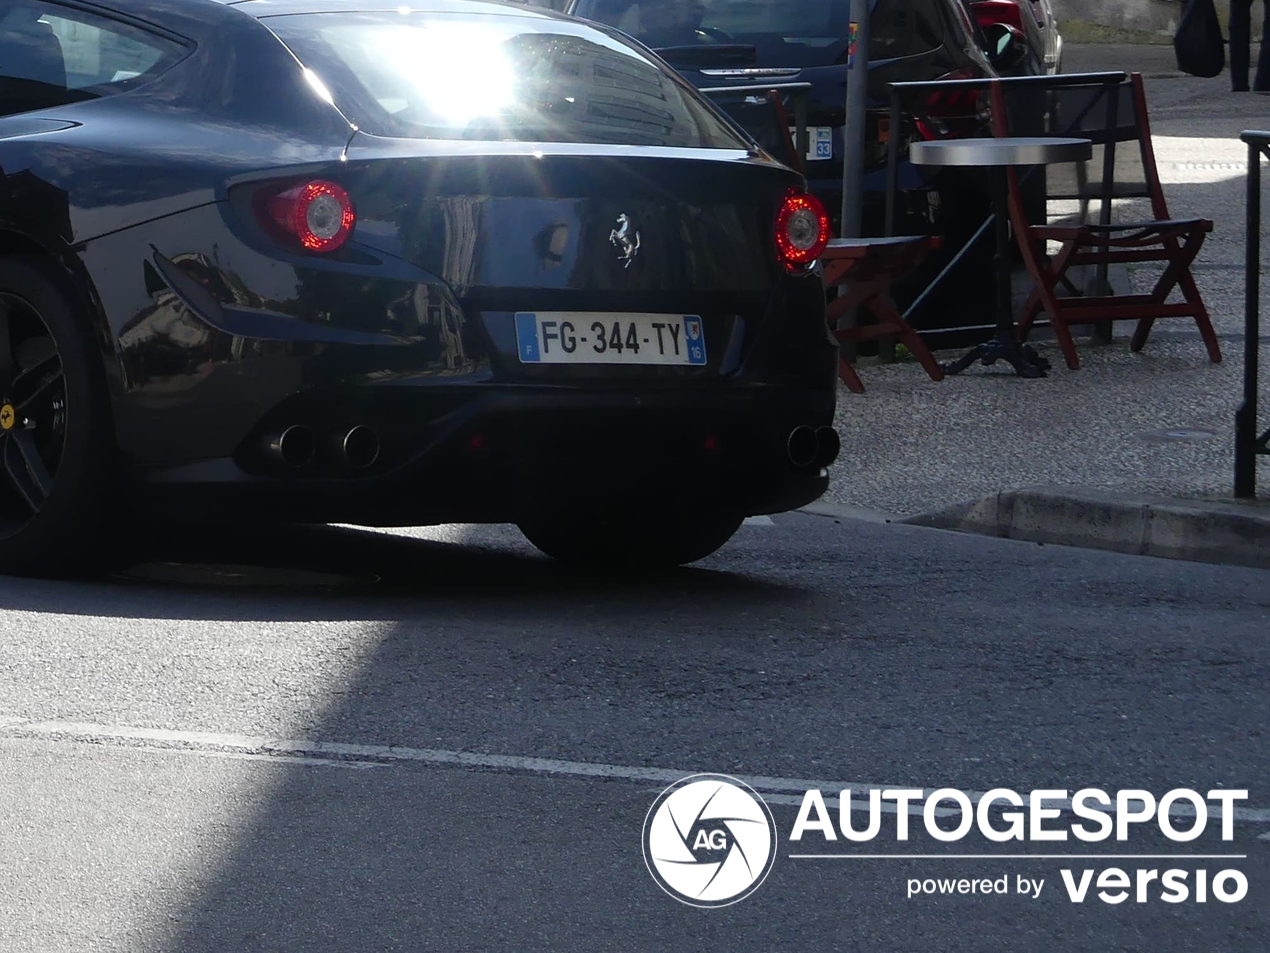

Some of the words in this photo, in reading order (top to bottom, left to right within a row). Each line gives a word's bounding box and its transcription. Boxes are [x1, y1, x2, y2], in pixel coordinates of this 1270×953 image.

[817, 143, 830, 154] 33
[541, 321, 680, 355] FG-344-TY
[526, 345, 532, 354] F
[691, 347, 702, 359] 16
